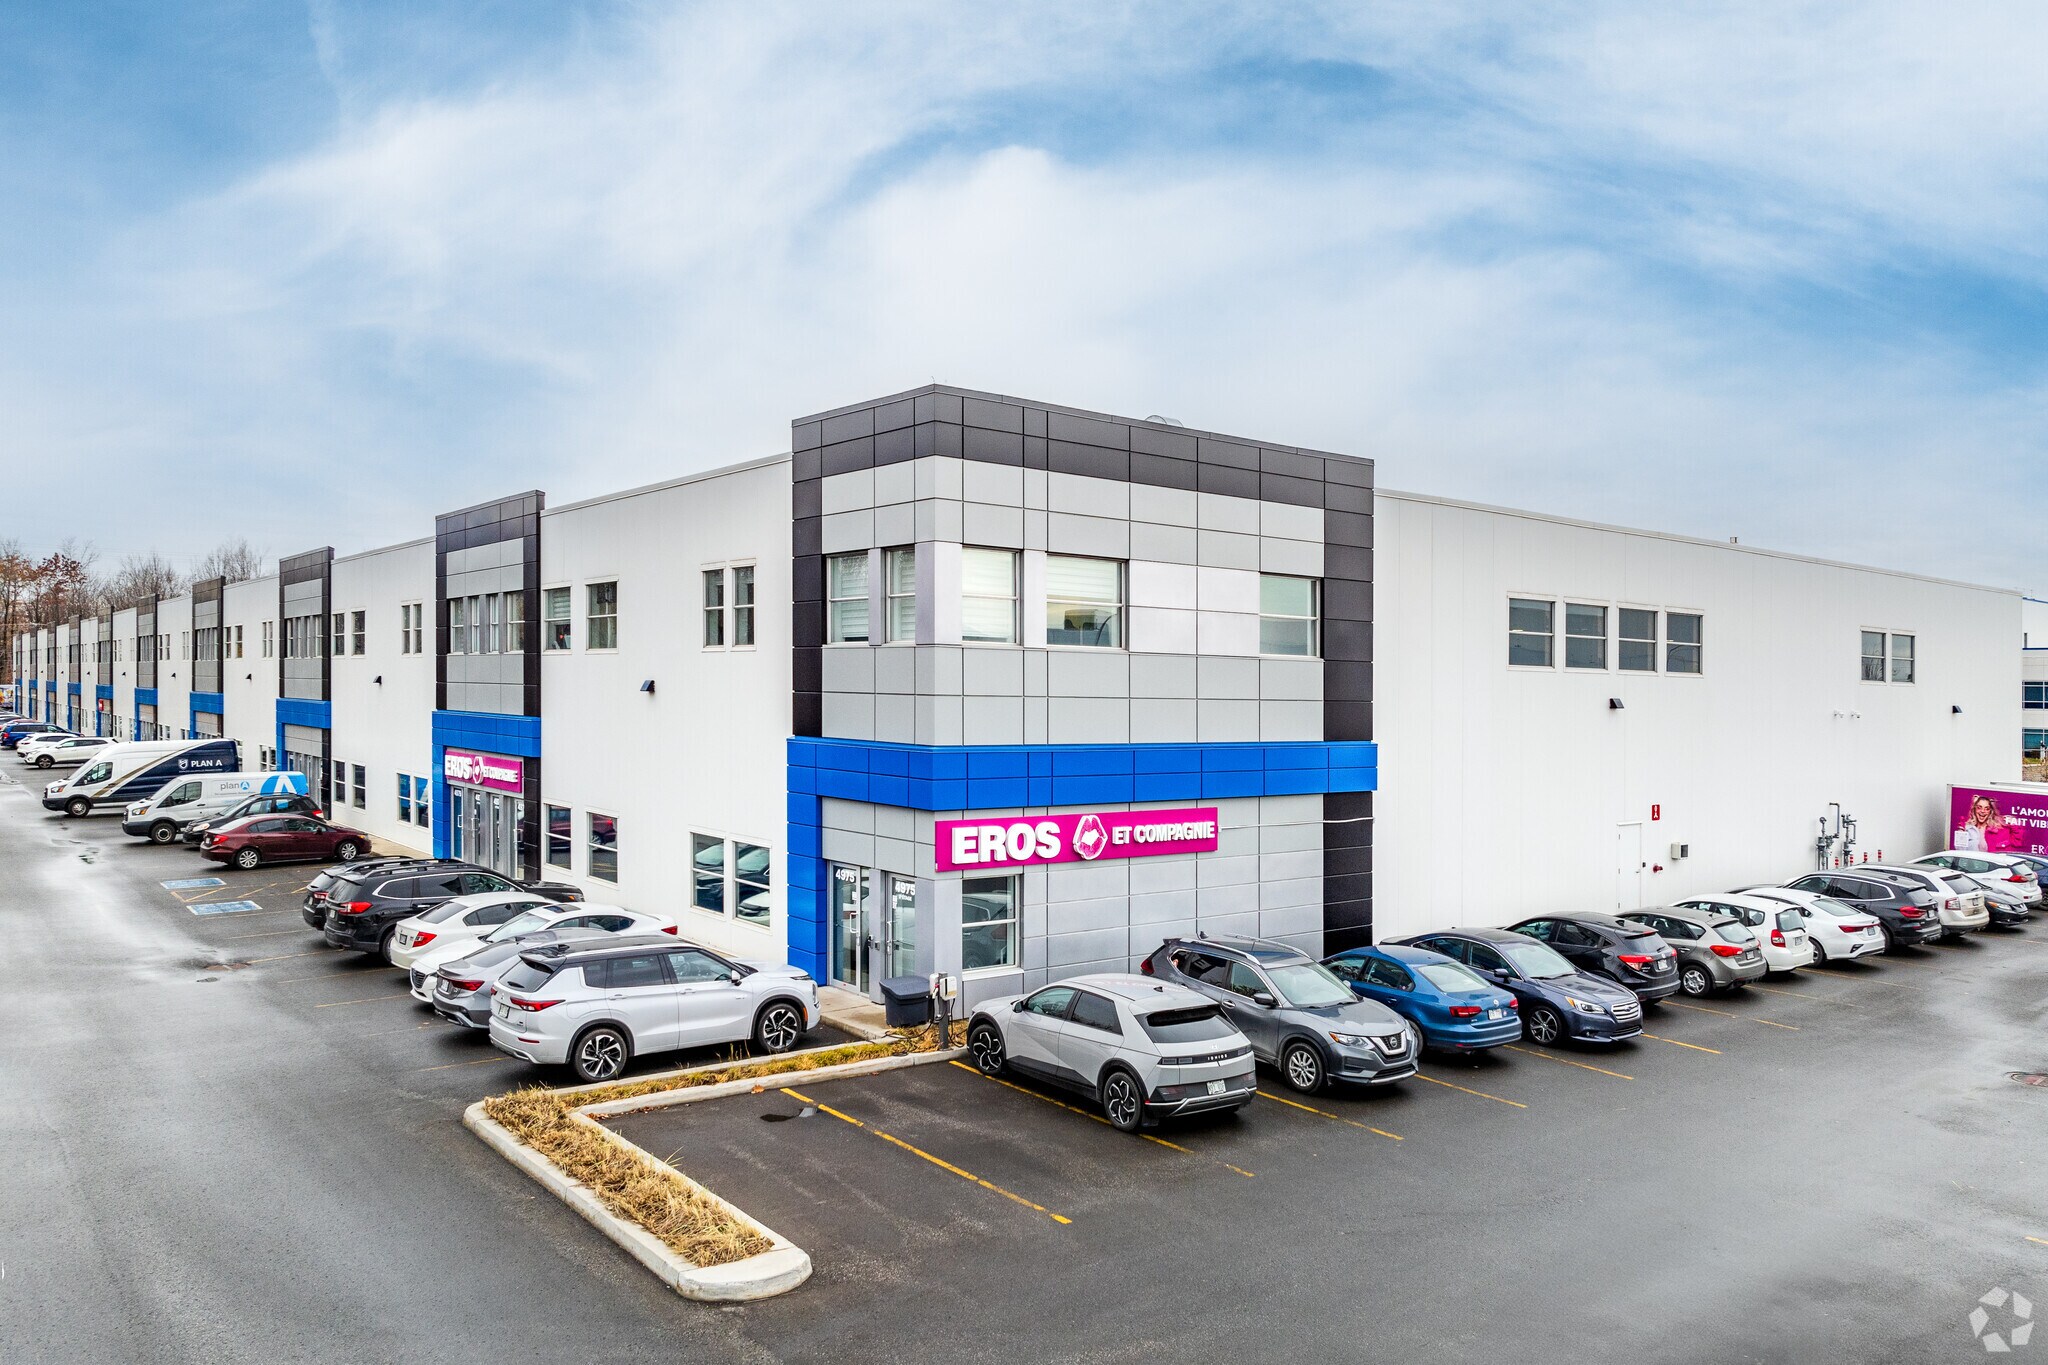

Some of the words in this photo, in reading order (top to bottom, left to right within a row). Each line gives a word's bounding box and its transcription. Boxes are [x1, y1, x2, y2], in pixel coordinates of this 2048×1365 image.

[445, 755, 472, 779] EROS
[2005, 816, 2028, 827] FAIT
[2029, 819, 2048, 829] VIB
[951, 821, 1061, 865] EROS
[1112, 826, 1133, 845] ET
[1133, 821, 1216, 843] COMPAGNIE
[2031, 844, 2048, 855] ER
[835, 868, 856, 883] 4975
[894, 880, 916, 896] 4975
